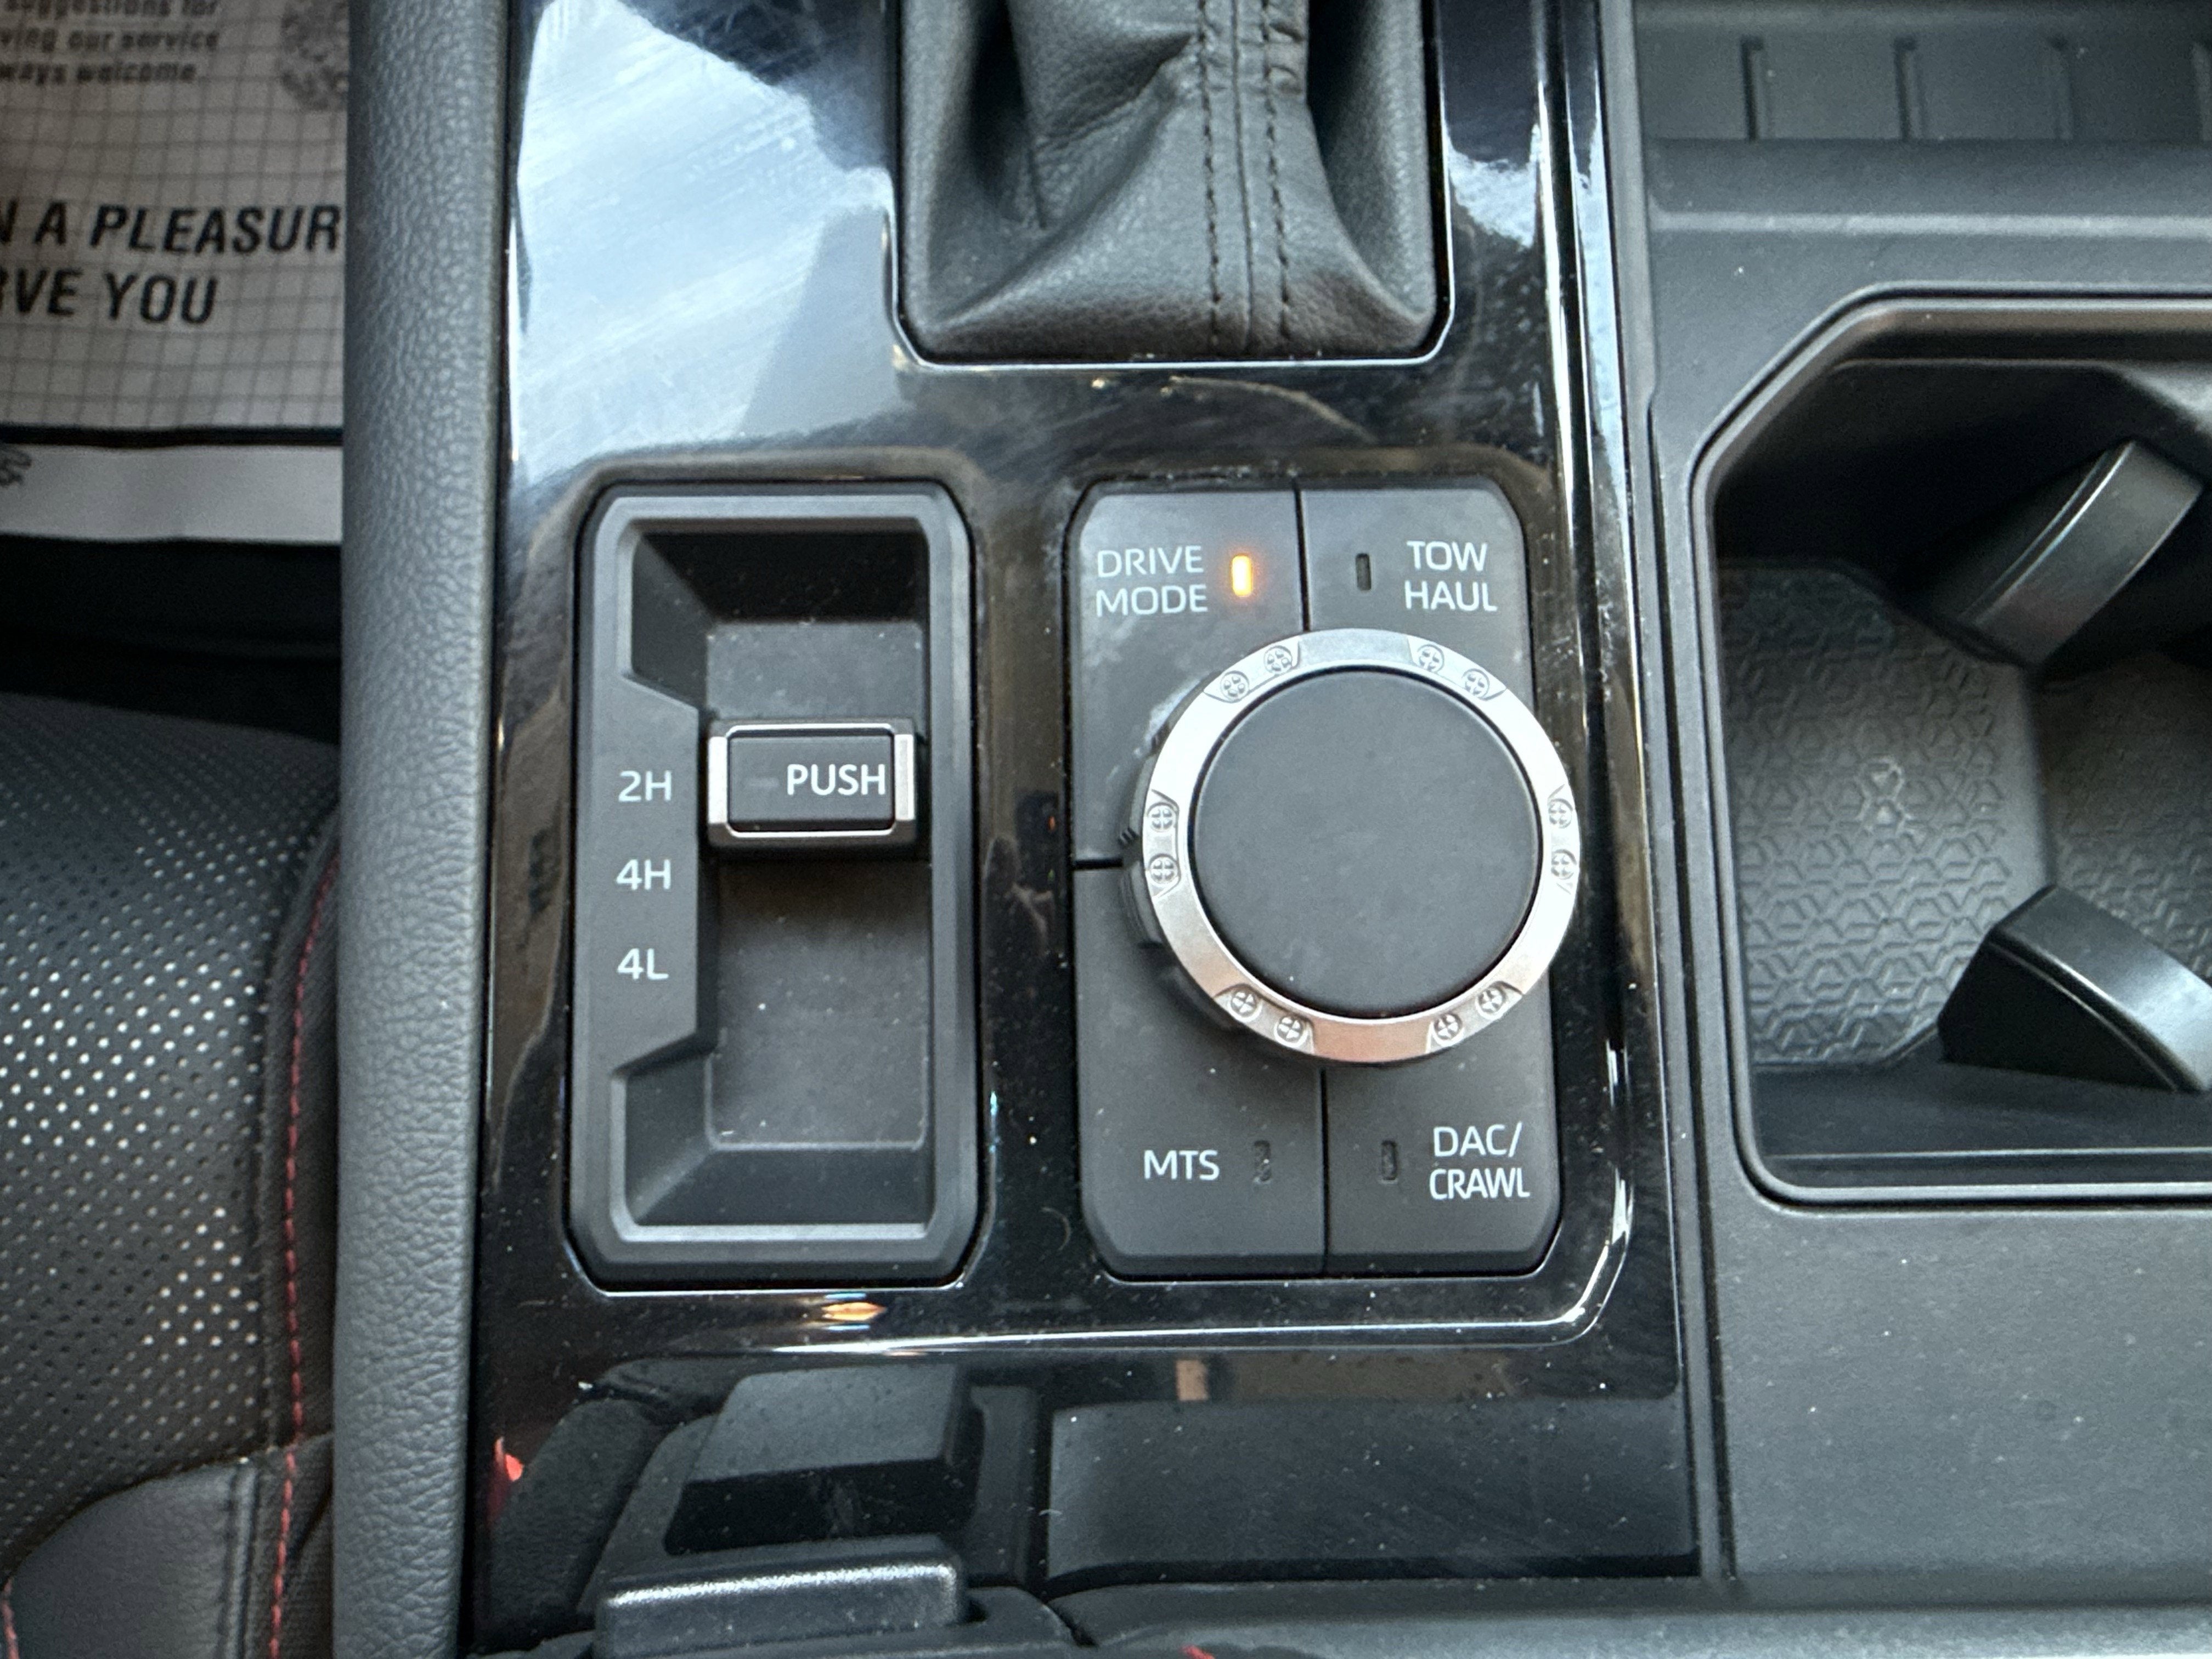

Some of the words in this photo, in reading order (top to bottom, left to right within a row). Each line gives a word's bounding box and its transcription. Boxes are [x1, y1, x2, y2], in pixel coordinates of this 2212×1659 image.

[32, 201, 66, 247] A
[89, 204, 341, 255] PLEASUR
[103, 272, 218, 324] YOU
[1098, 546, 1203, 577] DRIVE
[1407, 541, 1487, 571] TOW
[1096, 584, 1207, 617] MODE
[1405, 580, 1497, 611] HAUL
[619, 771, 671, 802] 2H
[788, 764, 885, 795] PUSH
[617, 860, 670, 890] 4H
[618, 949, 668, 979] 4L
[1434, 1121, 1522, 1157] DAC/
[1144, 1150, 1219, 1180] MTS
[1430, 1168, 1530, 1199] CRAWL
